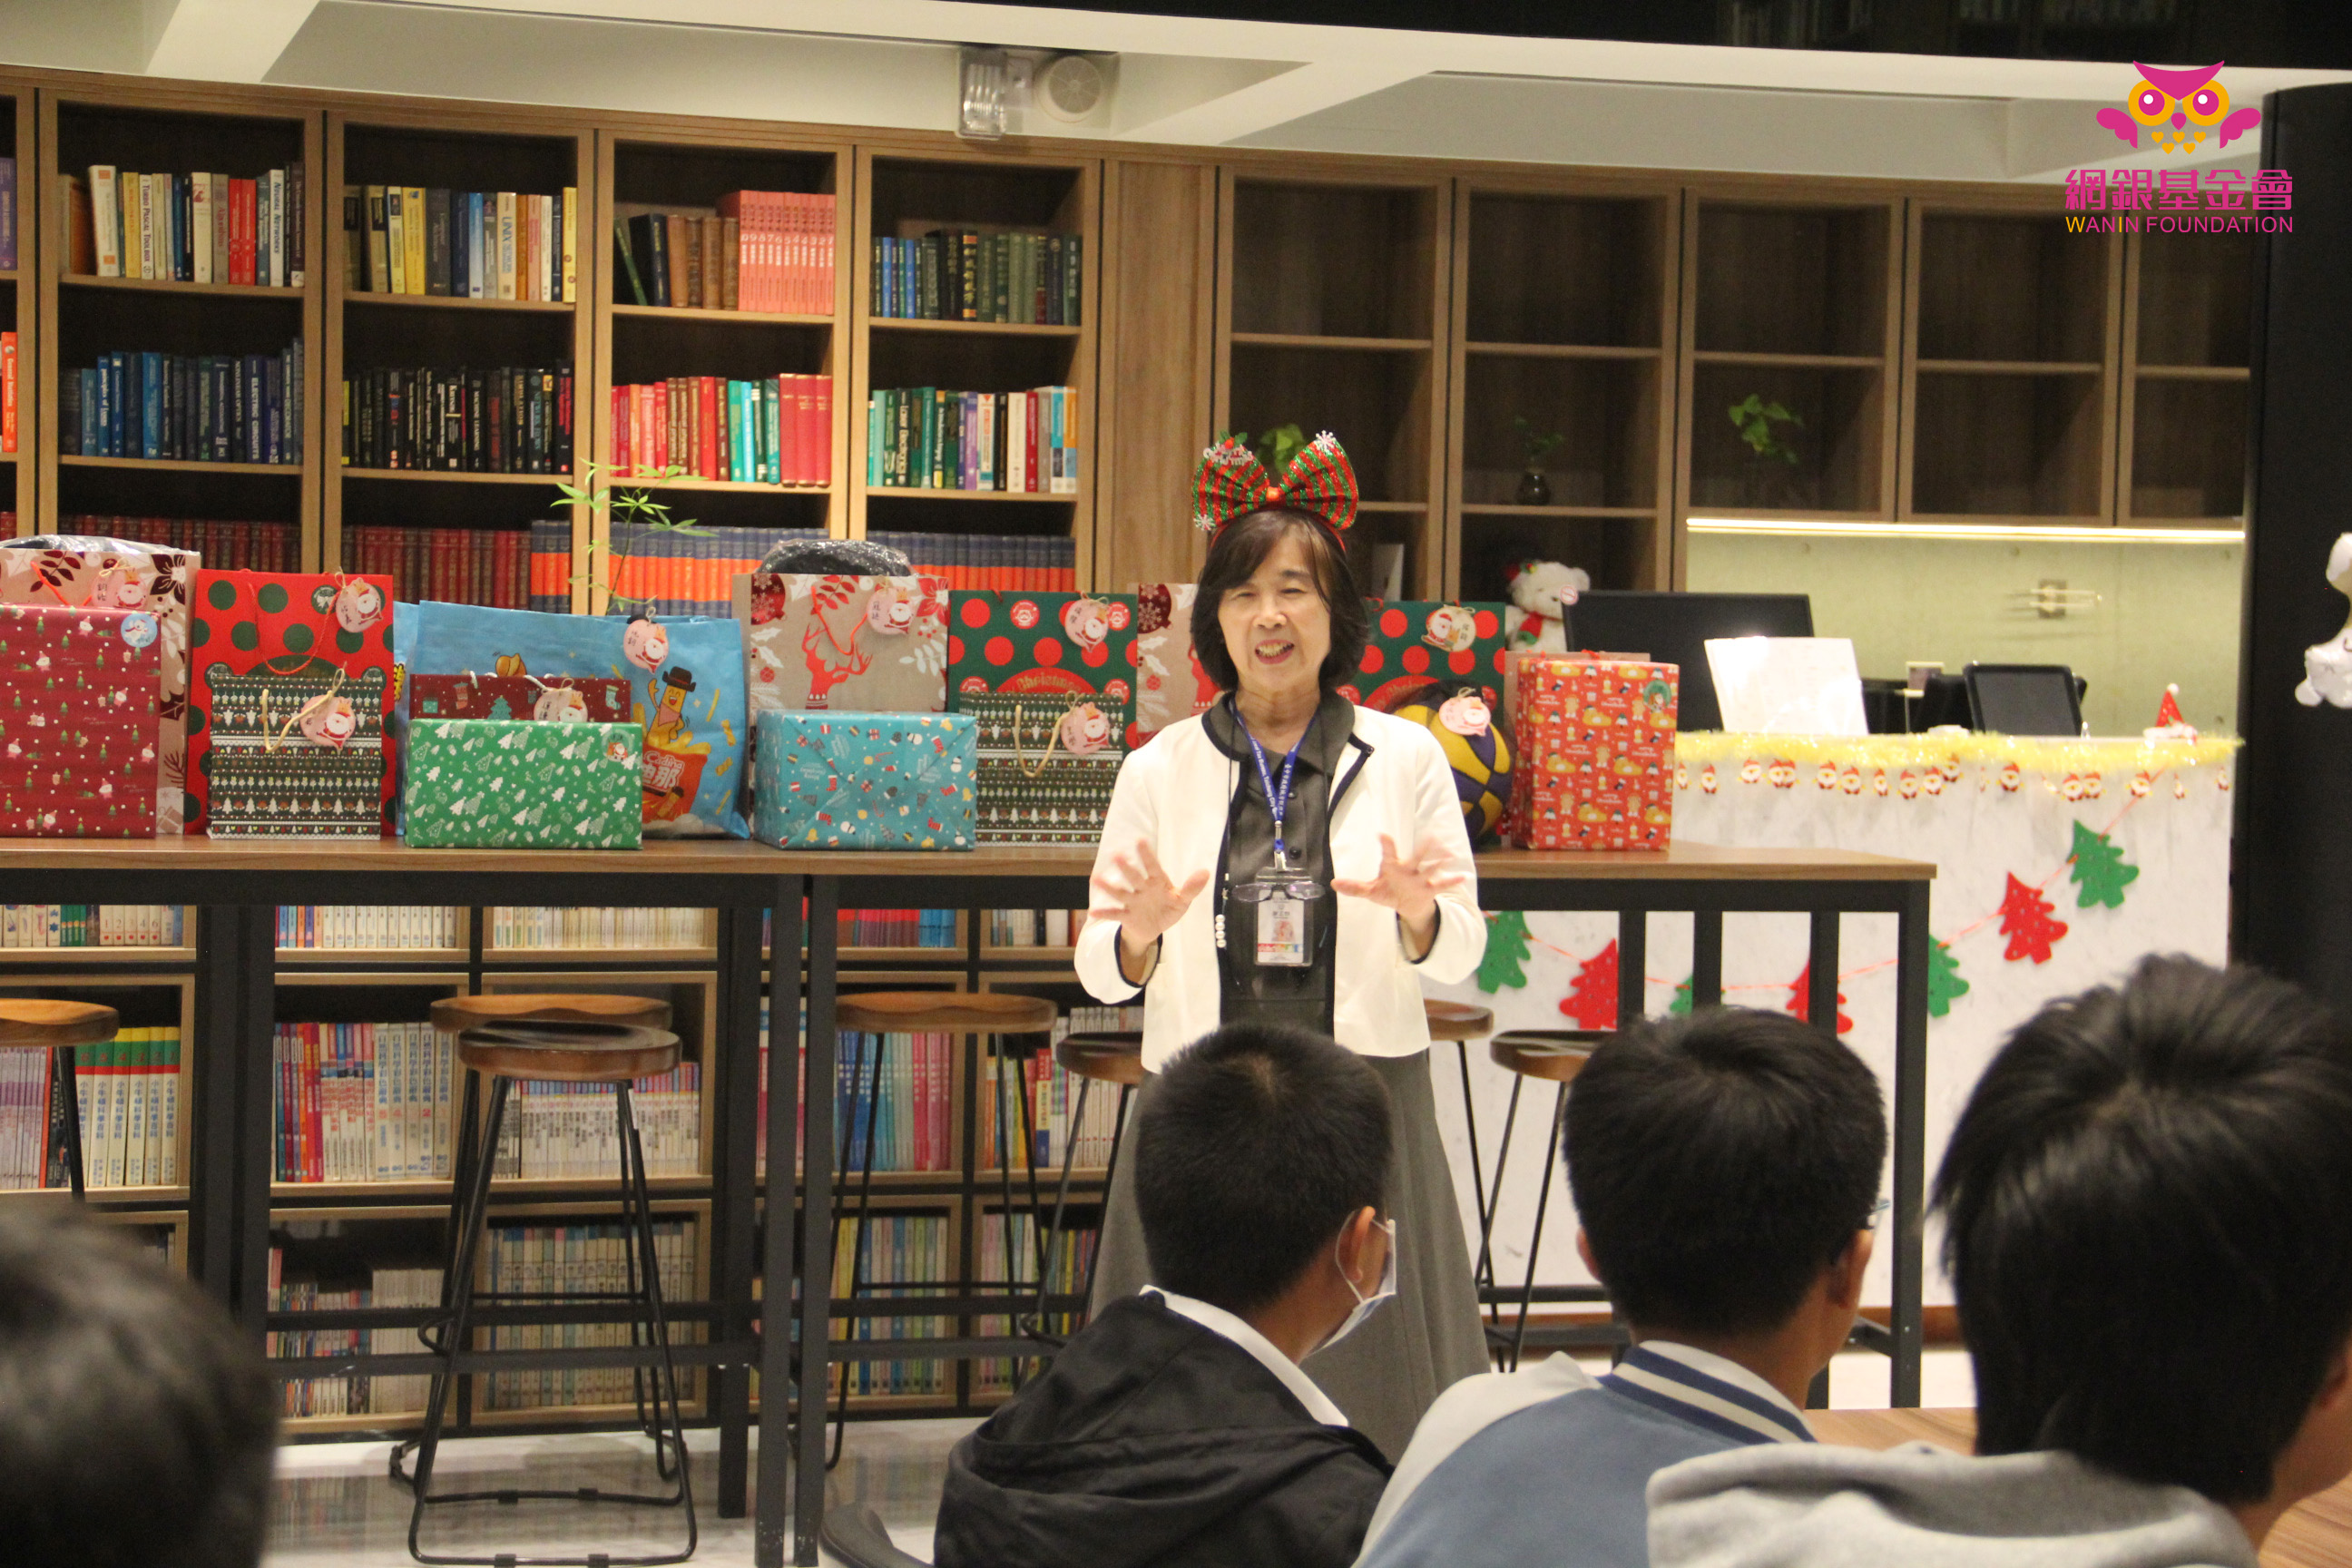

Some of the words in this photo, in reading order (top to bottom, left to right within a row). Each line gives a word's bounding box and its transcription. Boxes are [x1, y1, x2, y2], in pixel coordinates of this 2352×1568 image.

[273, 181, 281, 211] NEURAL
[142, 208, 151, 231] PASCAL
[502, 216, 513, 242] UNIX
[143, 234, 152, 262] TOOLBOX
[251, 377, 260, 418] ELECTRIC
[251, 420, 260, 459] CIRCUITS
[116, 919, 122, 928] 2
[140, 918, 146, 928] 4
[422, 1108, 432, 1118] 2
